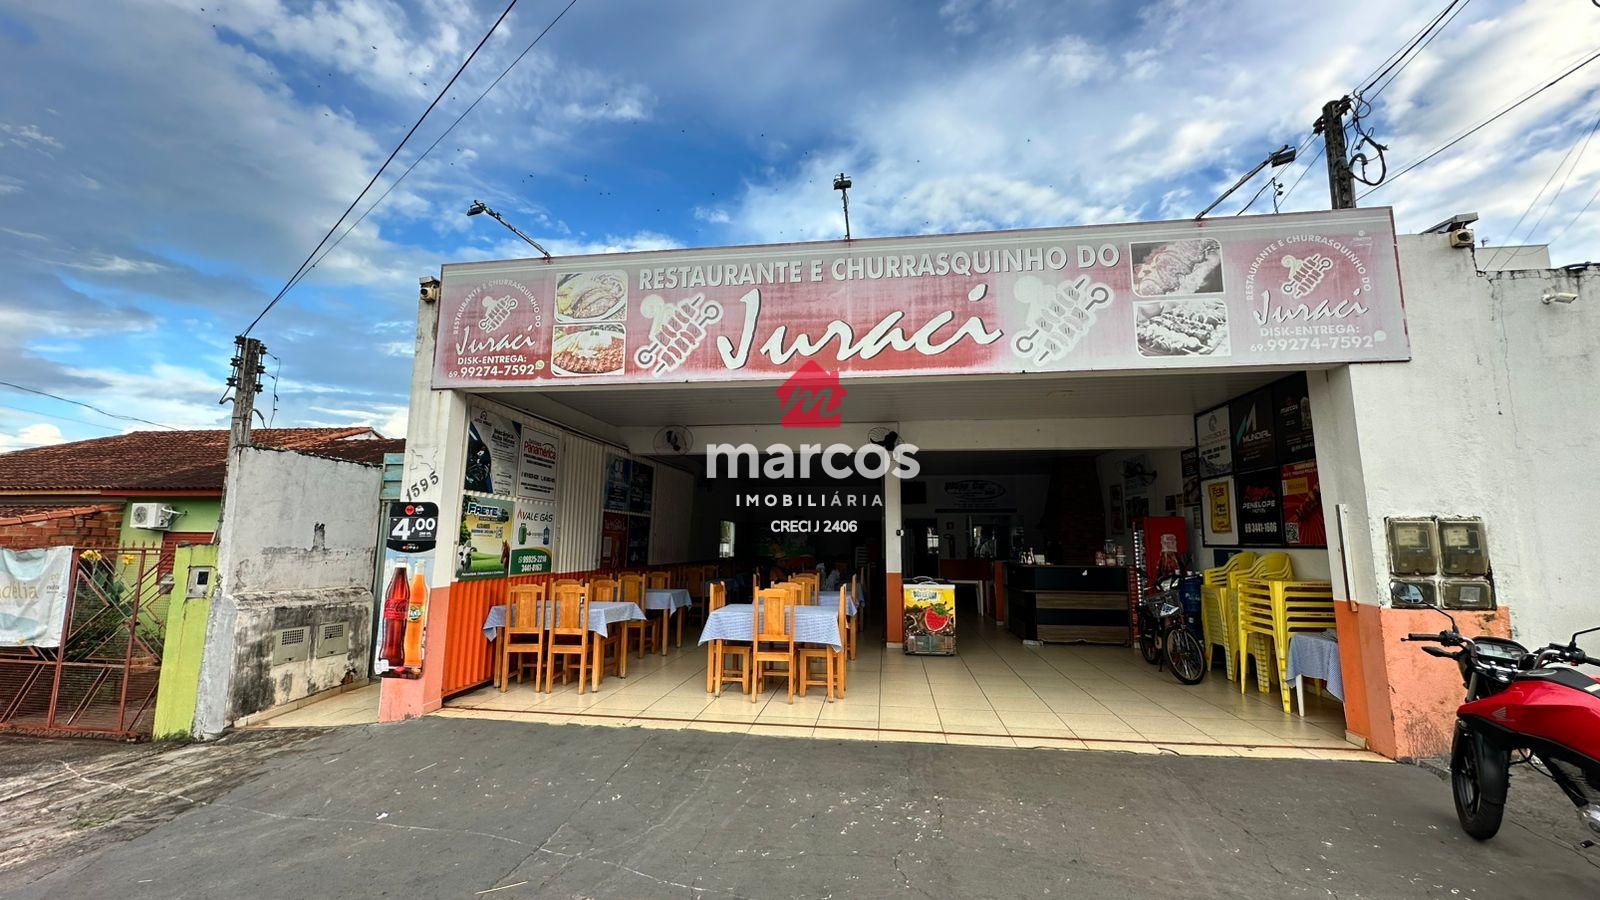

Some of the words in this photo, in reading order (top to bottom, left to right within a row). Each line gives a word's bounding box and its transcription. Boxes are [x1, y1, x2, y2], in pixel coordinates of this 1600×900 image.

[639, 260, 803, 291] RESTAURANTE
[810, 259, 824, 282] E
[831, 246, 1068, 281] CHURRASQUINHO
[1077, 243, 1120, 269] DO
[1245, 243, 1277, 301] RESTAURANTE
[1278, 239, 1285, 247] E
[1286, 234, 1366, 275] CHURRASQUINHO
[1361, 276, 1372, 291] DO
[453, 287, 482, 335] RESTAURANTE
[489, 279, 540, 314] CHURRASQUINHO
[534, 315, 541, 328] DO
[1253, 288, 1369, 326] Juraci
[455, 325, 536, 355] Juraci
[717, 283, 1004, 370] Juraci
[1260, 324, 1360, 337] DISK-ENTREGA:
[457, 354, 527, 365] DISK-ENTREGA:
[406, 470, 440, 502] 1595
[391, 517, 437, 541] 4,00
